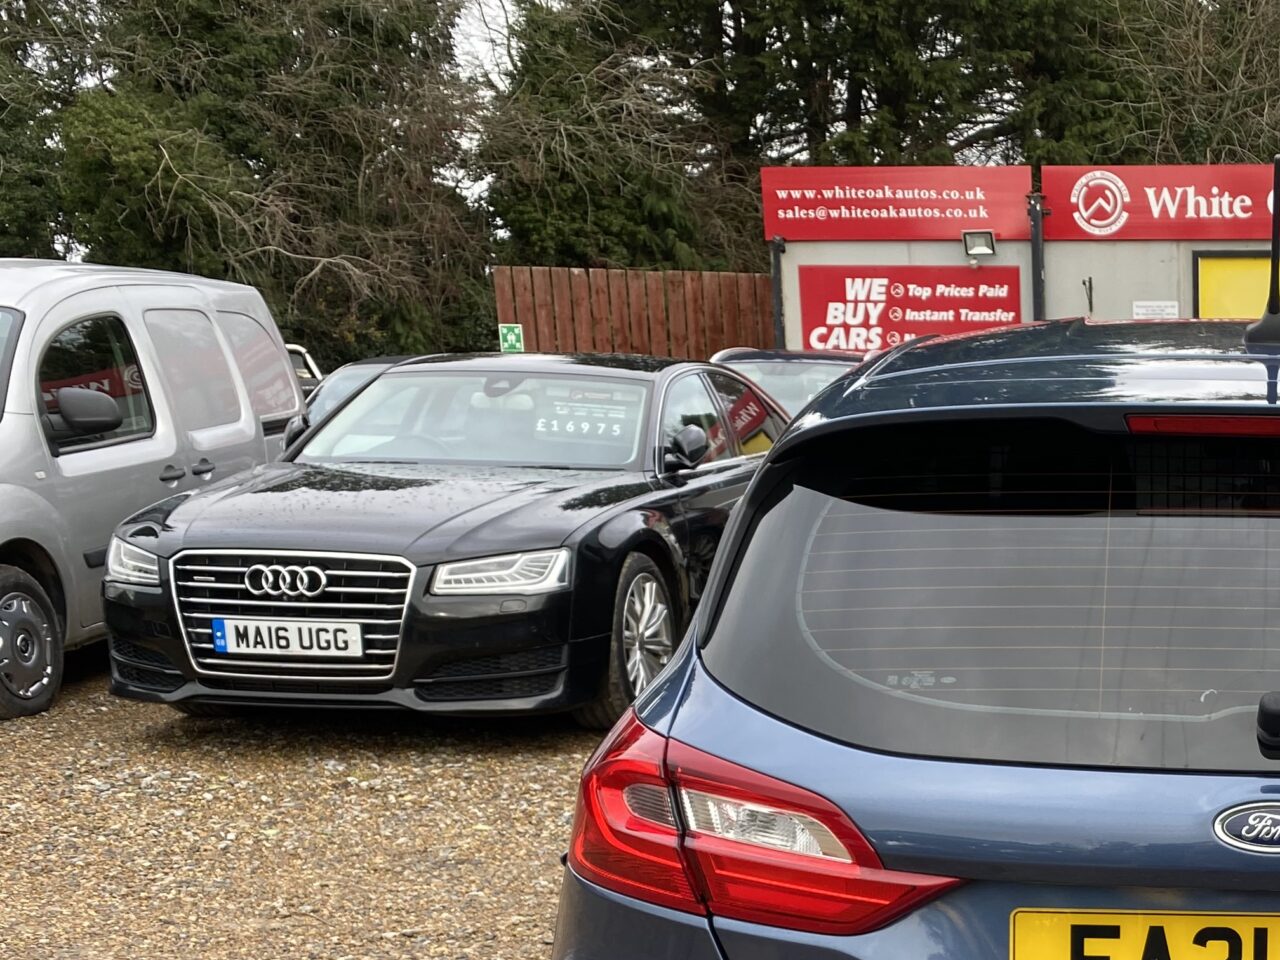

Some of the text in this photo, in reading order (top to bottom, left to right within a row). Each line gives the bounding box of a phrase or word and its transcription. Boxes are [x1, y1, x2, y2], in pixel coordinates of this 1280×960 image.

[775, 185, 986, 200] www.whiteoakautos.co.uk
[1144, 186, 1253, 219] White
[777, 205, 989, 220] sales@whiteoakautos.co.uk
[845, 277, 889, 301] WE
[907, 284, 1009, 300] Top Prices Paid
[826, 302, 886, 326] BUY
[905, 308, 1016, 322] Instant Transfer
[809, 326, 883, 351] CARS
[536, 418, 621, 436] £16975
[234, 624, 349, 651] MA16 UGG
